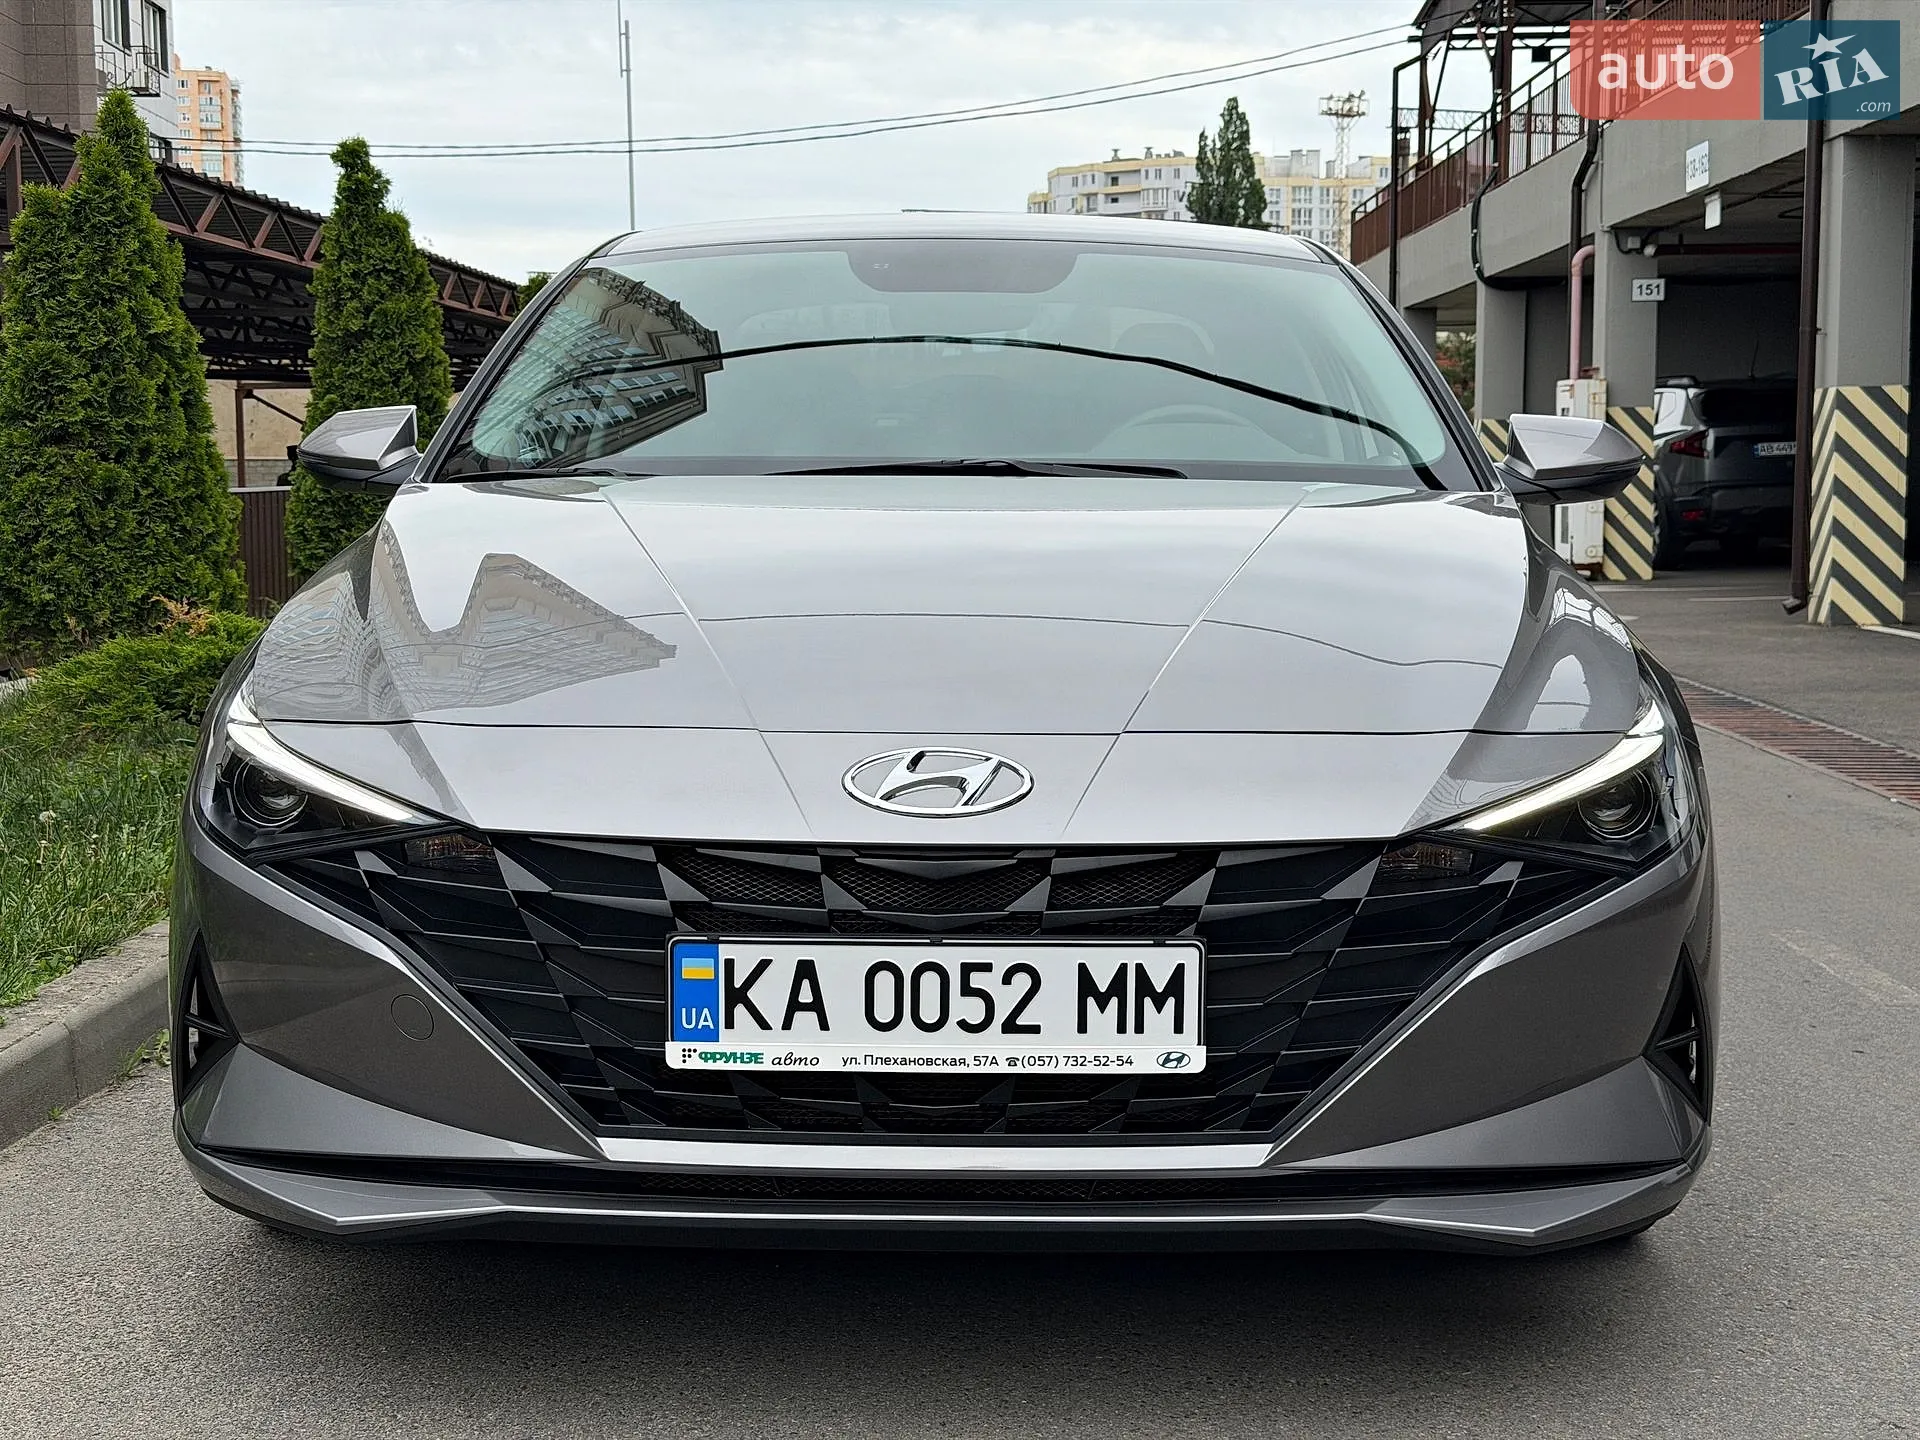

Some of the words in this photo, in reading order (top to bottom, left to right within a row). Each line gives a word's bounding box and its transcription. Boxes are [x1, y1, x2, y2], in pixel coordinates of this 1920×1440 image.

[1637, 284, 1660, 296] 151
[724, 958, 830, 1031] KA
[864, 960, 1042, 1034] 0052
[1077, 962, 1186, 1034] MM
[681, 1008, 714, 1029] UA
[698, 1051, 764, 1064] ФРУНЗЕ
[842, 1056, 861, 1067] ул.
[864, 1054, 970, 1068] Плехановская,
[973, 1055, 999, 1067] 57А
[1021, 1055, 1058, 1068] (057)
[1062, 1055, 1134, 1067] 732-52-54
